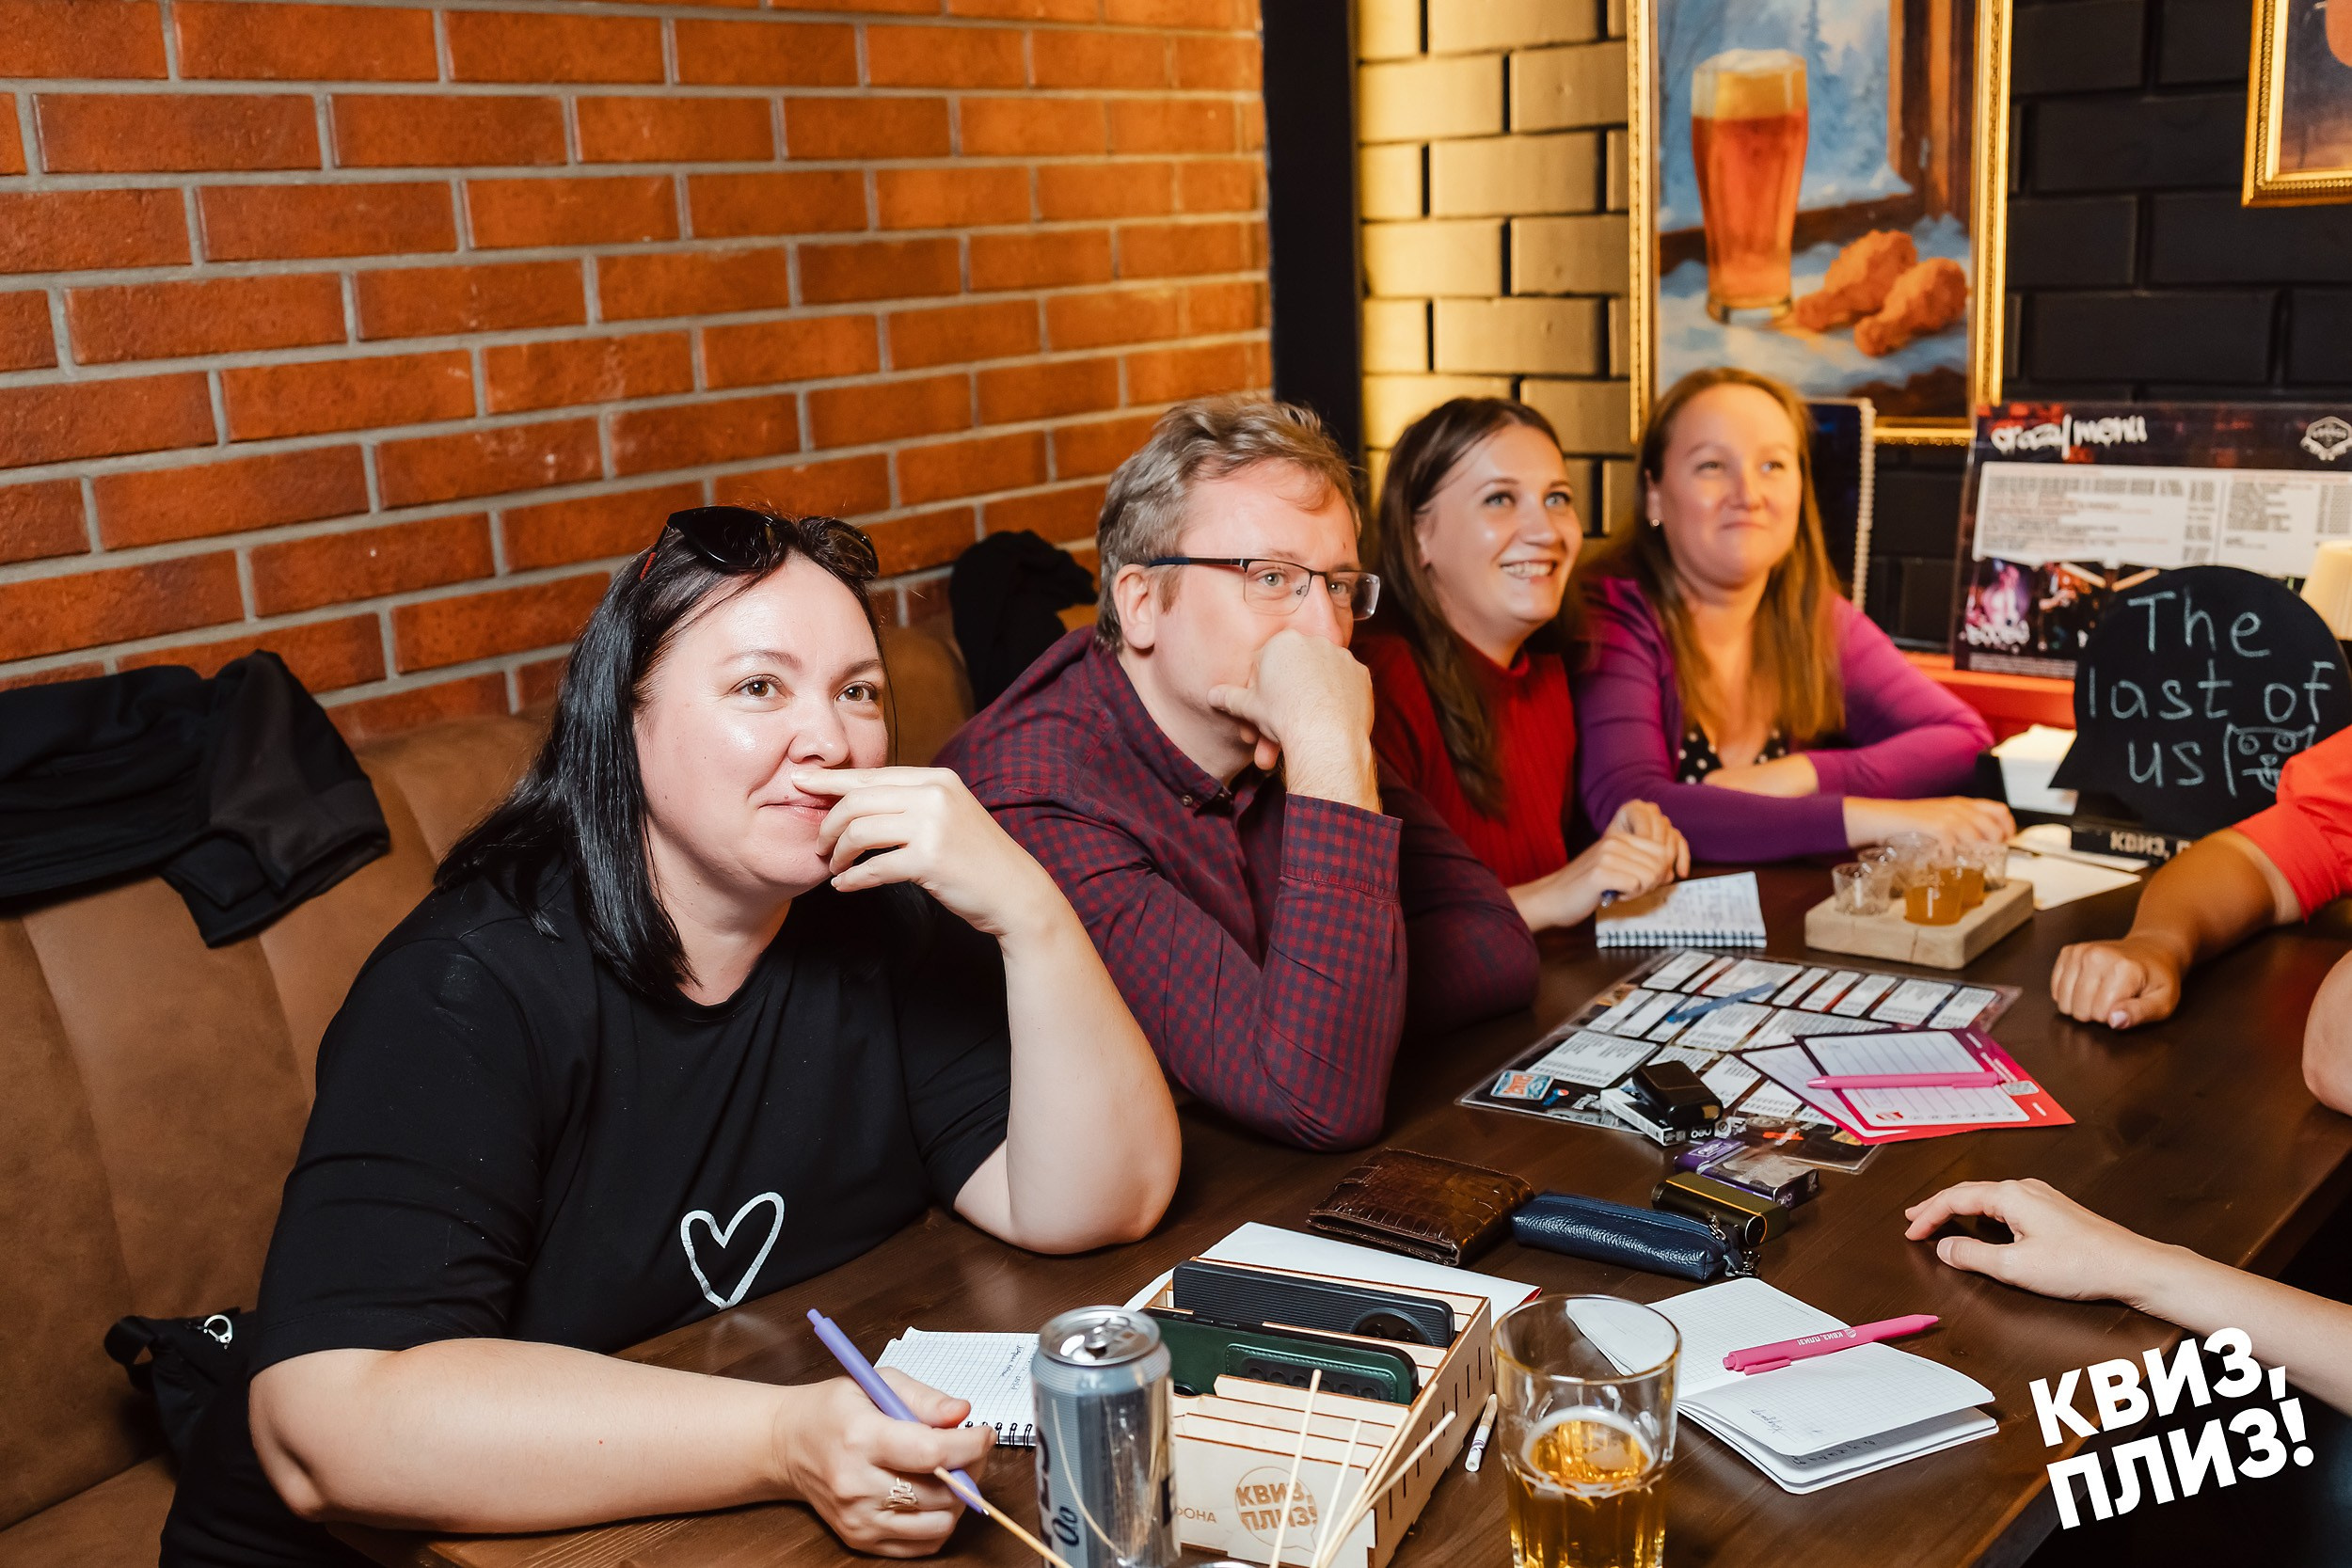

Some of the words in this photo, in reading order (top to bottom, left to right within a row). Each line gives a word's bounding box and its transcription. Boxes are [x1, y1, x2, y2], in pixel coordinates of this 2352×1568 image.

[2127, 584, 2271, 657] The
[2088, 659, 2233, 719] last
[2264, 660, 2335, 723] of
[2128, 739, 2205, 788] us
[1796, 1336, 1820, 1345] ПЛИЗ!
